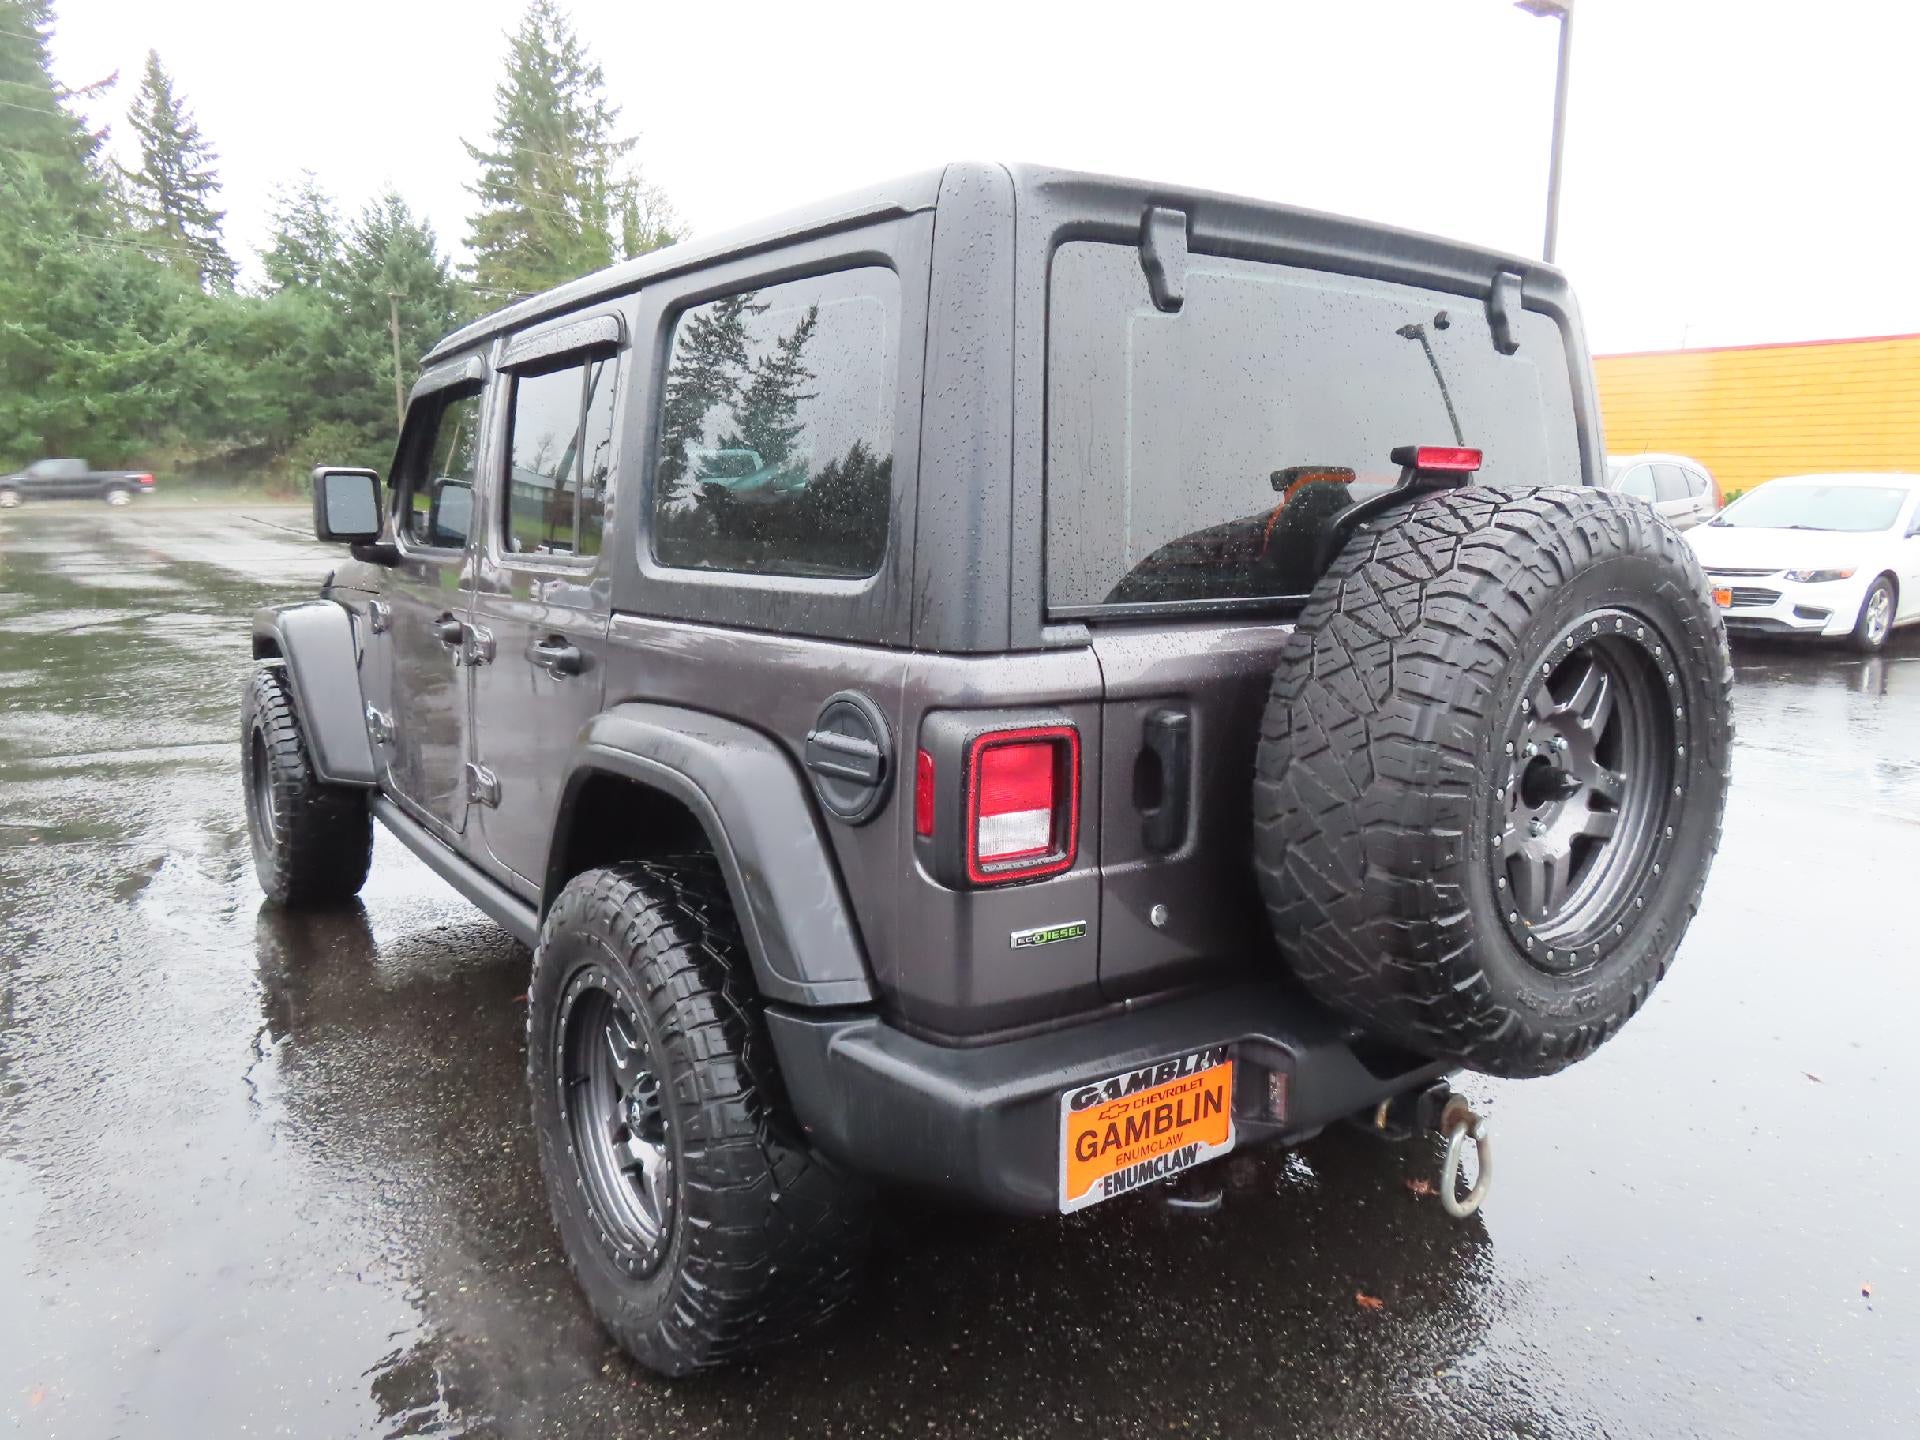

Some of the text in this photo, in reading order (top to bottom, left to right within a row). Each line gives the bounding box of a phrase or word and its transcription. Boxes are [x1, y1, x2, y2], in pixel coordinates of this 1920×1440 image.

[1070, 1046, 1228, 1111] GAMBLIN
[1133, 1077, 1204, 1109] CHEVROLET
[1075, 1086, 1222, 1162] GAMBLIN
[1115, 1132, 1184, 1166] ENUMCLAW
[1103, 1142, 1199, 1196] ENUMCLAW
